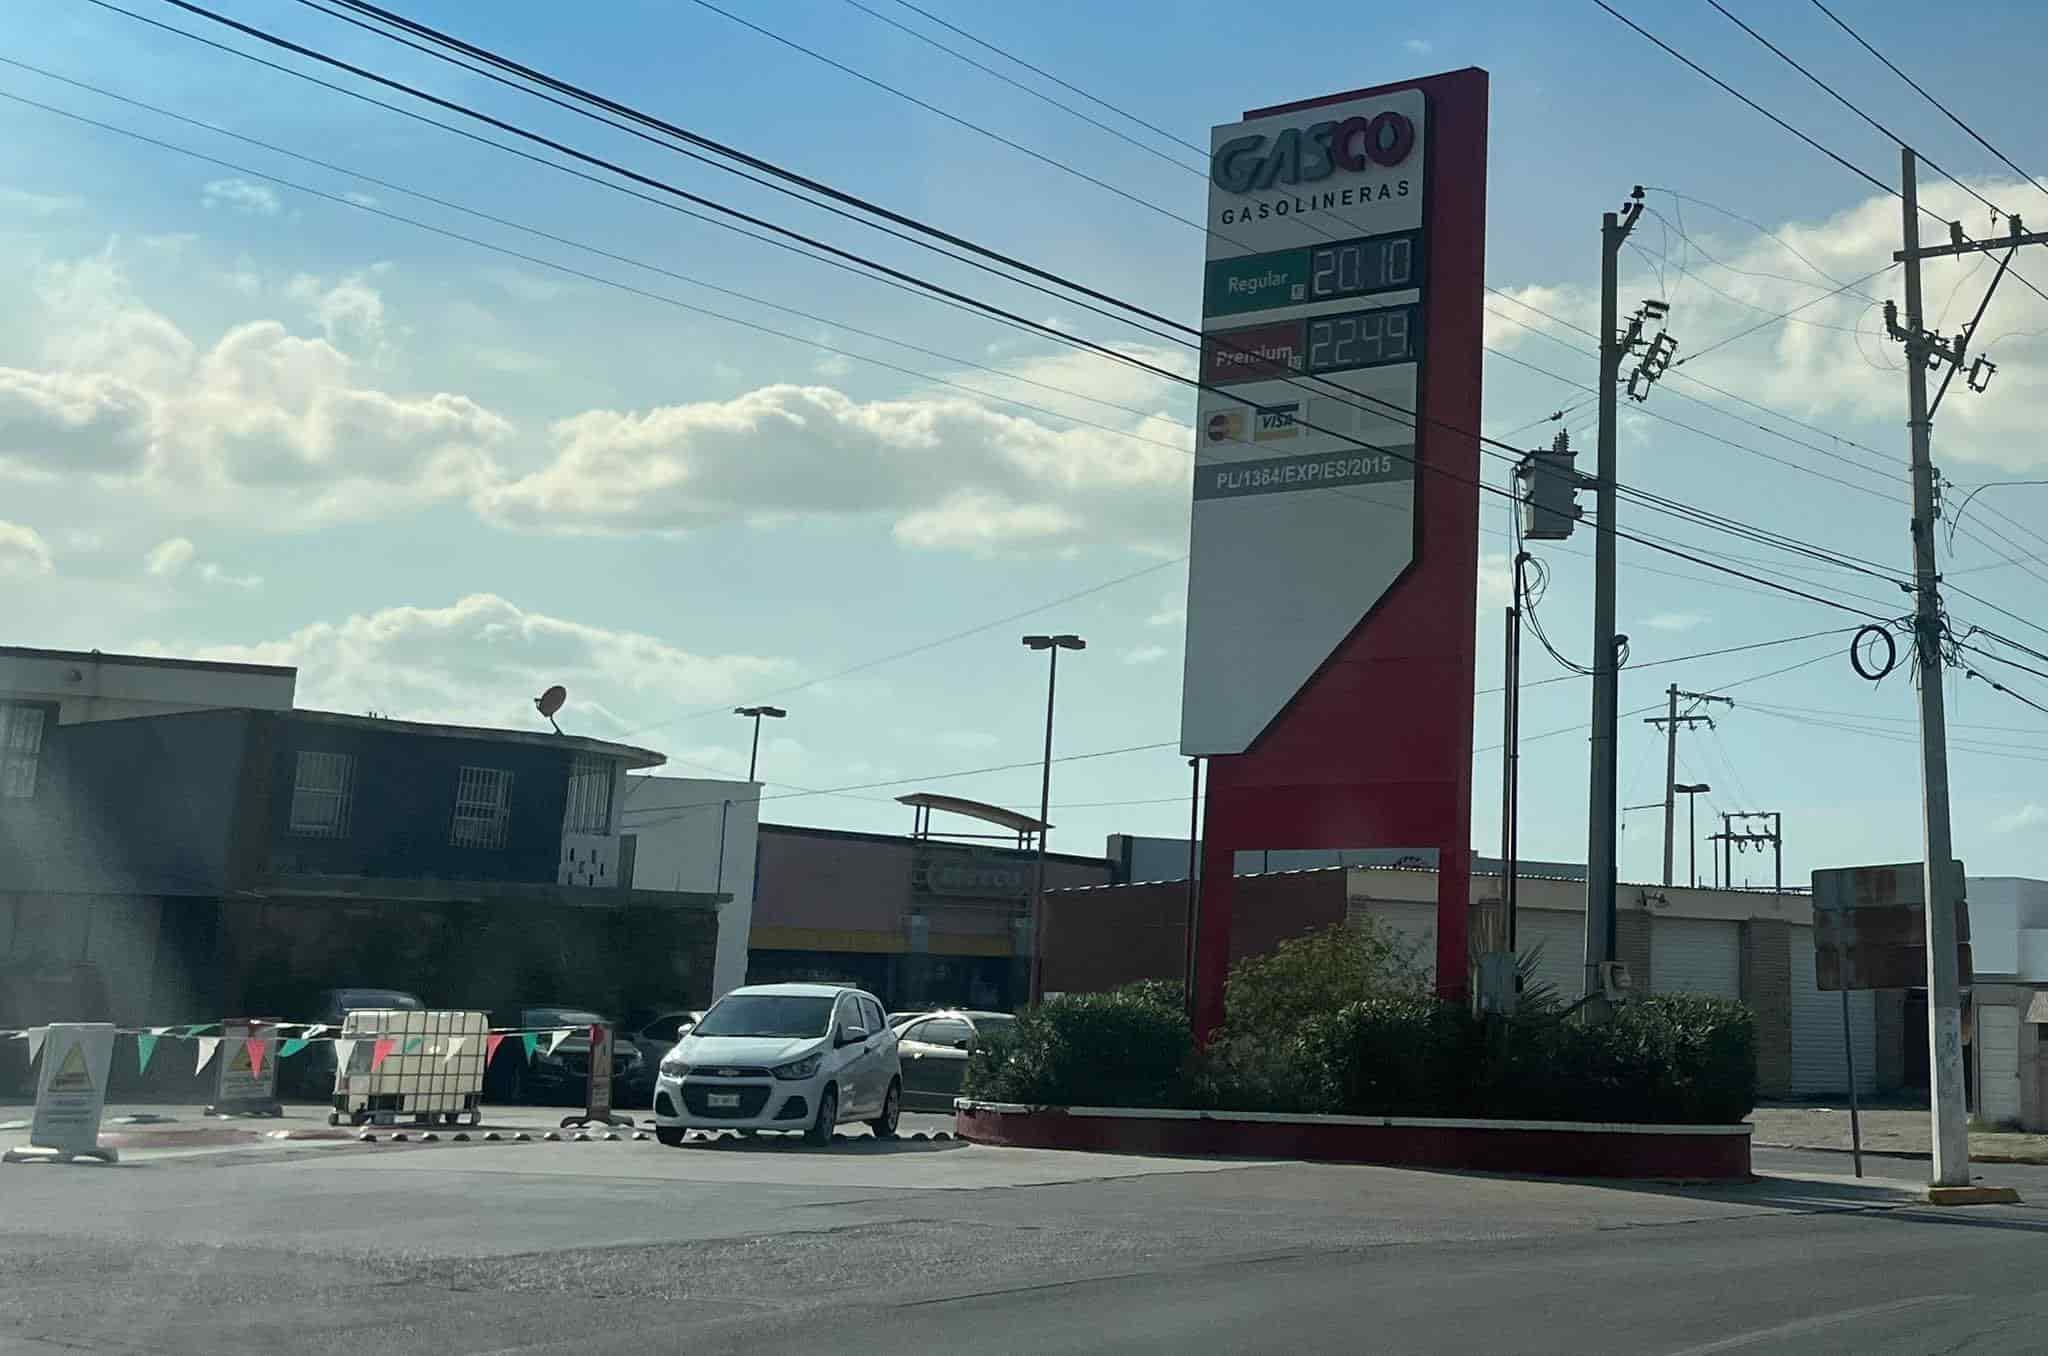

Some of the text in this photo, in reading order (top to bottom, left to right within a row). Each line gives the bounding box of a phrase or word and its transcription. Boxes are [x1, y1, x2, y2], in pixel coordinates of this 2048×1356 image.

[1211, 112, 1415, 194] GASCO
[1221, 180, 1410, 225] GASOLINERAS
[1228, 270, 1288, 295] Regular
